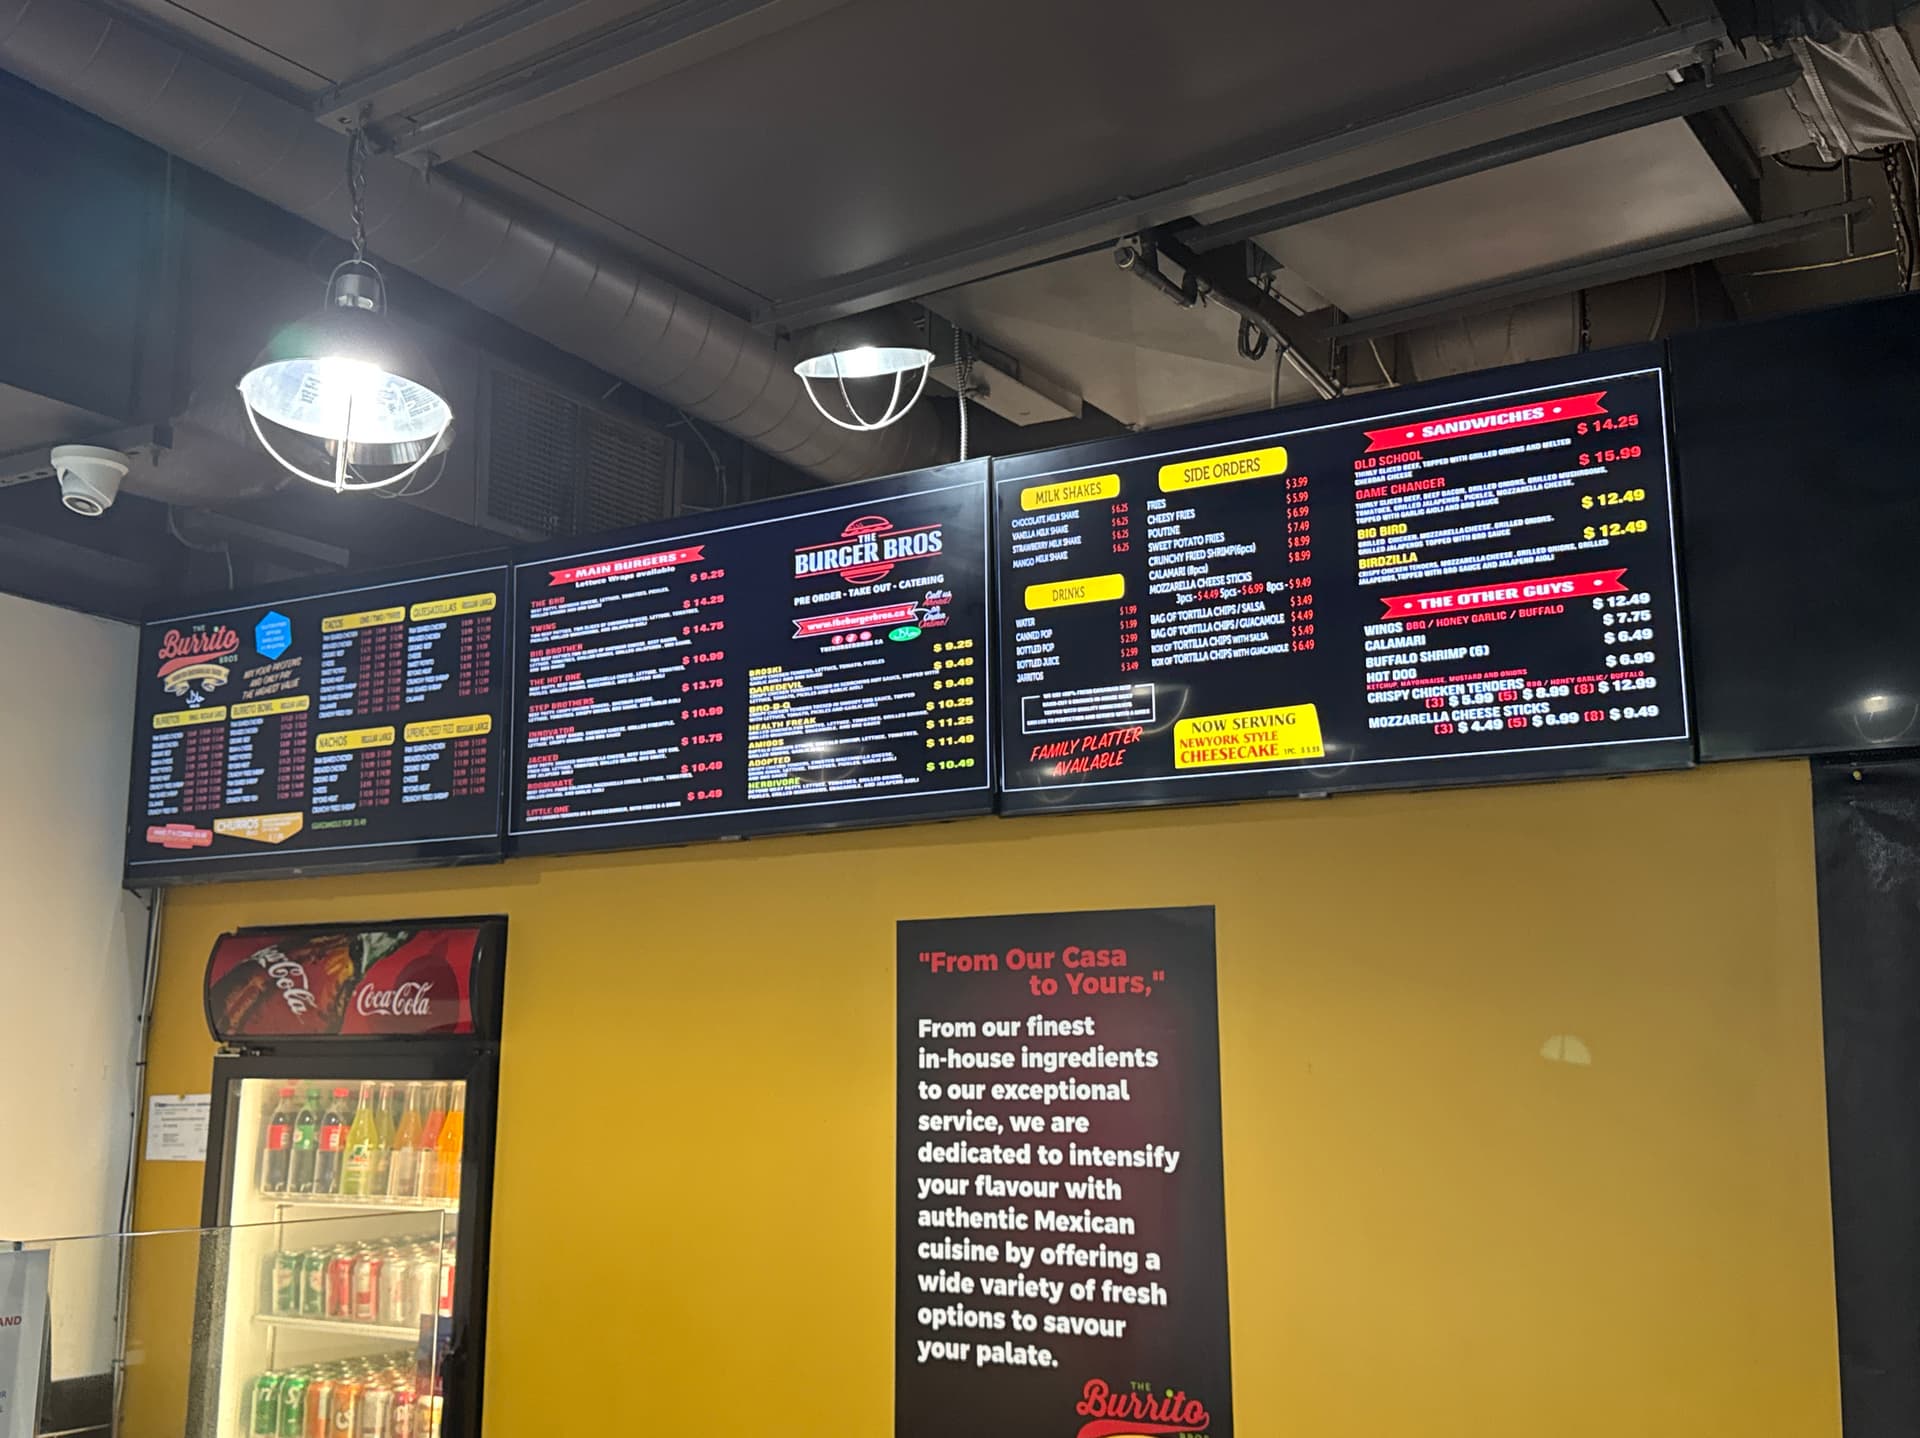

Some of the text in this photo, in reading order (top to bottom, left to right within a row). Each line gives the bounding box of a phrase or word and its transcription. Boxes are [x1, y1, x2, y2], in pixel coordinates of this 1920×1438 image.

[1422, 407, 1544, 438] SANDWICHES
[1184, 458, 1260, 483] SIDE ORDERS
[1354, 451, 1423, 470] OLD SCHOOL
[1036, 483, 1102, 504] MILK SHAKES
[1356, 477, 1446, 500] GAME CHANGER
[1147, 499, 1166, 510] FRIES
[1147, 508, 1196, 525] CHEESY FRIES
[858, 532, 877, 544] THE
[1148, 525, 1180, 538] POUTINE
[1357, 523, 1408, 540] BIG BIRD
[795, 530, 942, 574] BURGER BROS
[1149, 532, 1224, 552] SWEET POTATO FRIES
[576, 553, 677, 578] MAIN BURGERS
[1149, 553, 1184, 566] CRUNCHY
[1185, 550, 1206, 562] FRIED
[1359, 552, 1418, 570] BIRDZILLA
[576, 566, 676, 588] Lettuce Wraps available
[1150, 567, 1186, 580] CALAMARI
[1150, 572, 1252, 594] MOZZARELLA CHEESE STICKS
[794, 574, 944, 606] PRE ORDER TAKE OUT CATERING
[1052, 586, 1086, 602] DRINKS
[1418, 581, 1574, 610] THE OTHER GUYS
[531, 596, 566, 608] THE BRO
[193, 625, 205, 633] THE
[530, 622, 557, 632] TWINS
[1364, 622, 1403, 637] WINGS
[1406, 619, 1426, 632] BBQ
[1436, 615, 1470, 628] HONEY
[1471, 611, 1508, 625] GARLIC
[1519, 604, 1564, 618] BUFFALO
[159, 625, 240, 659] Burrito
[530, 644, 583, 657] BIG BROTHER
[1365, 635, 1426, 652] CALAMARI
[219, 655, 238, 664] BROS
[1366, 645, 1490, 670] BUFFALO SHRIMP (6)
[530, 672, 582, 686] THE HOT ONE
[749, 666, 782, 676] BROSKI
[1367, 668, 1418, 683] HOT DOG
[749, 682, 802, 694] DAREDEVIL
[1368, 678, 1524, 704] CRISPY CHICKEN TENDERS
[530, 702, 552, 713] STEP
[553, 697, 595, 710] BROTHERS
[749, 717, 816, 731] HEALTH FREAK
[1192, 712, 1296, 734] NOW SERVING
[1369, 702, 1550, 729] MOZZARELLA CHEESE STICKS
[320, 735, 348, 747] NACHOS
[528, 726, 575, 738] INNOVATOR
[1180, 730, 1278, 748] NEWYORK STYLE
[749, 739, 784, 749] AMIGOS
[1030, 726, 1144, 762] FAMILY PLATTER
[1180, 744, 1278, 764] CHEESECAKE
[528, 754, 559, 764] JACKED
[749, 756, 791, 767] ADOPTED
[1053, 750, 1126, 776] AVAILABLE
[528, 778, 574, 790] ROOMMATE
[748, 777, 800, 789] HERBIVORE
[526, 806, 552, 816] LITTLE
[553, 805, 570, 814] ONE
[920, 946, 1127, 973] "From Our Casa
[1030, 970, 1165, 996] to Yours,"
[356, 982, 434, 1016] Coca-Cola
[918, 1014, 1095, 1038] From our finest
[918, 1045, 1159, 1073] in-house ingredients
[918, 1078, 1130, 1105] to our exceptional
[918, 1109, 1090, 1134] service, we are
[918, 1142, 1180, 1173] dedicated to intensify
[918, 1175, 1122, 1200] your flavour with
[918, 1206, 1135, 1234] authentic Mexican
[918, 1237, 1161, 1274] cuisine by offering a
[918, 1270, 1168, 1306] wide variety of fresh
[918, 1303, 1126, 1337] options to savour
[918, 1340, 1059, 1367] your palate.
[1130, 1382, 1152, 1392] THE
[1076, 1378, 1210, 1425] Burrito
